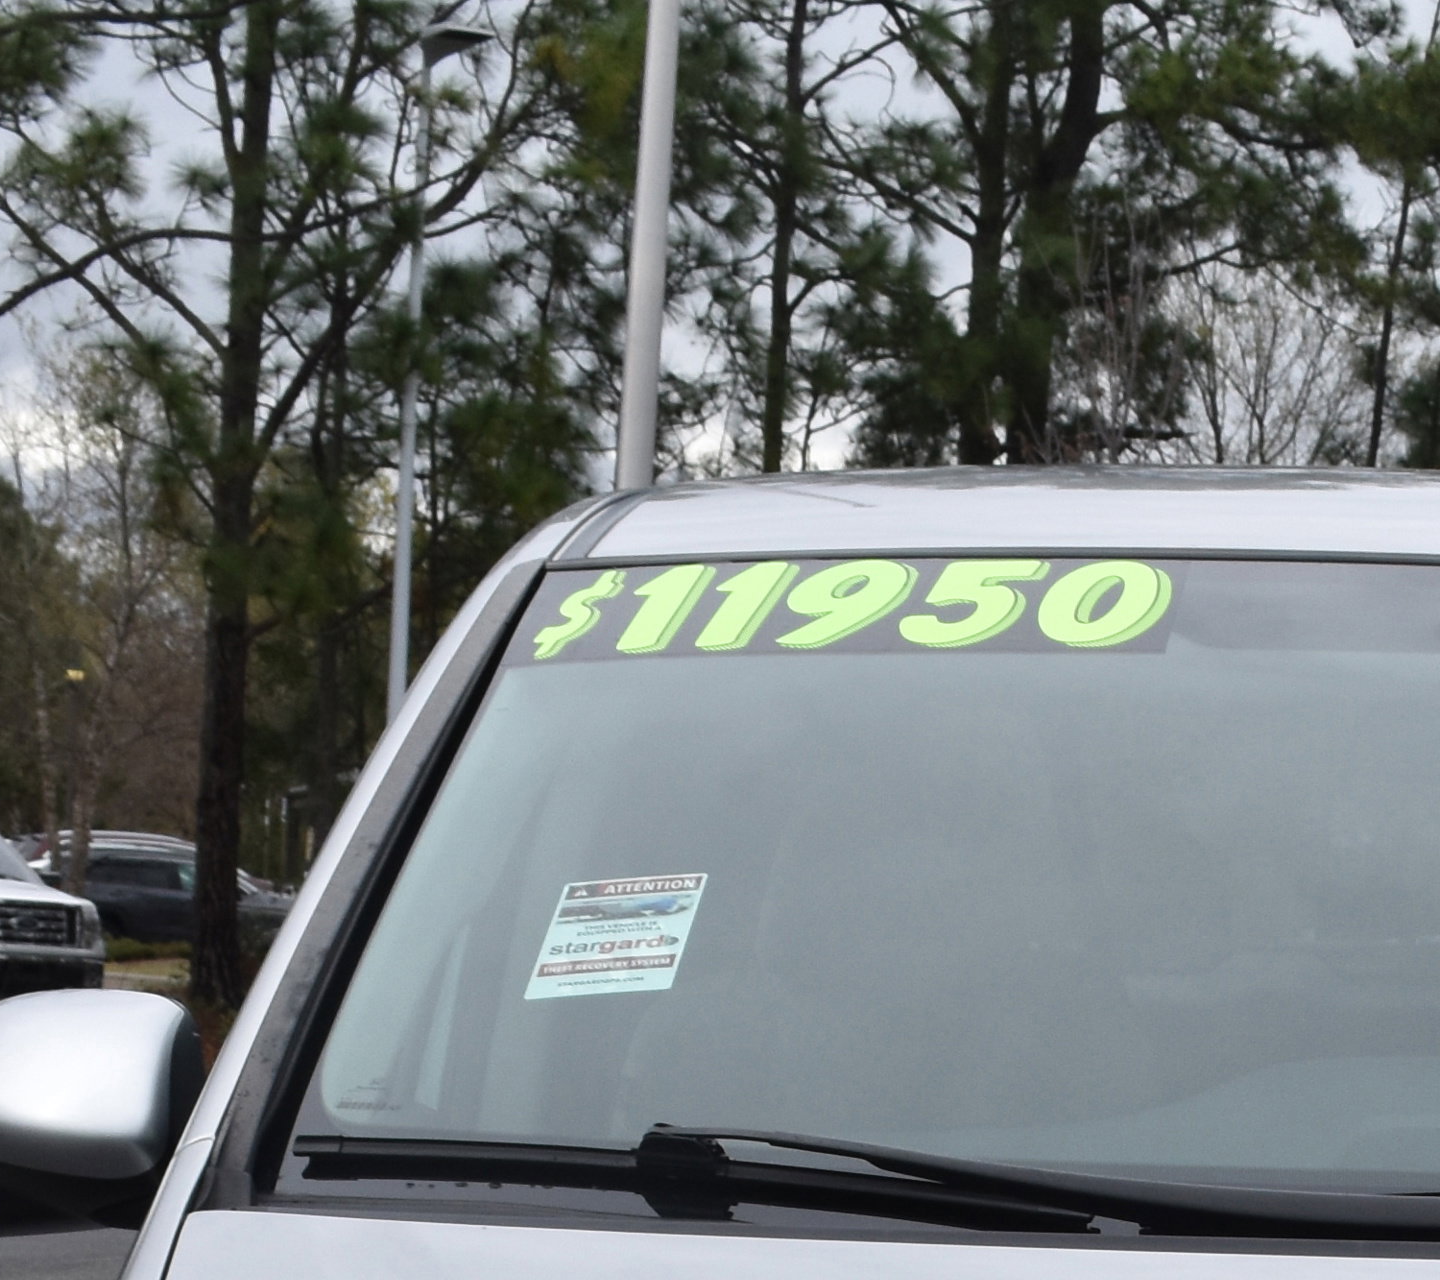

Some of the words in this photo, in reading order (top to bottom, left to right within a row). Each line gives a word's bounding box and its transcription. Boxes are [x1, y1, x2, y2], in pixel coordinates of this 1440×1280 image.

[533, 557, 1173, 660] $11950
[603, 879, 696, 895] ATTENTION
[549, 935, 666, 955] stargard
[574, 960, 630, 972] RECOVERY
